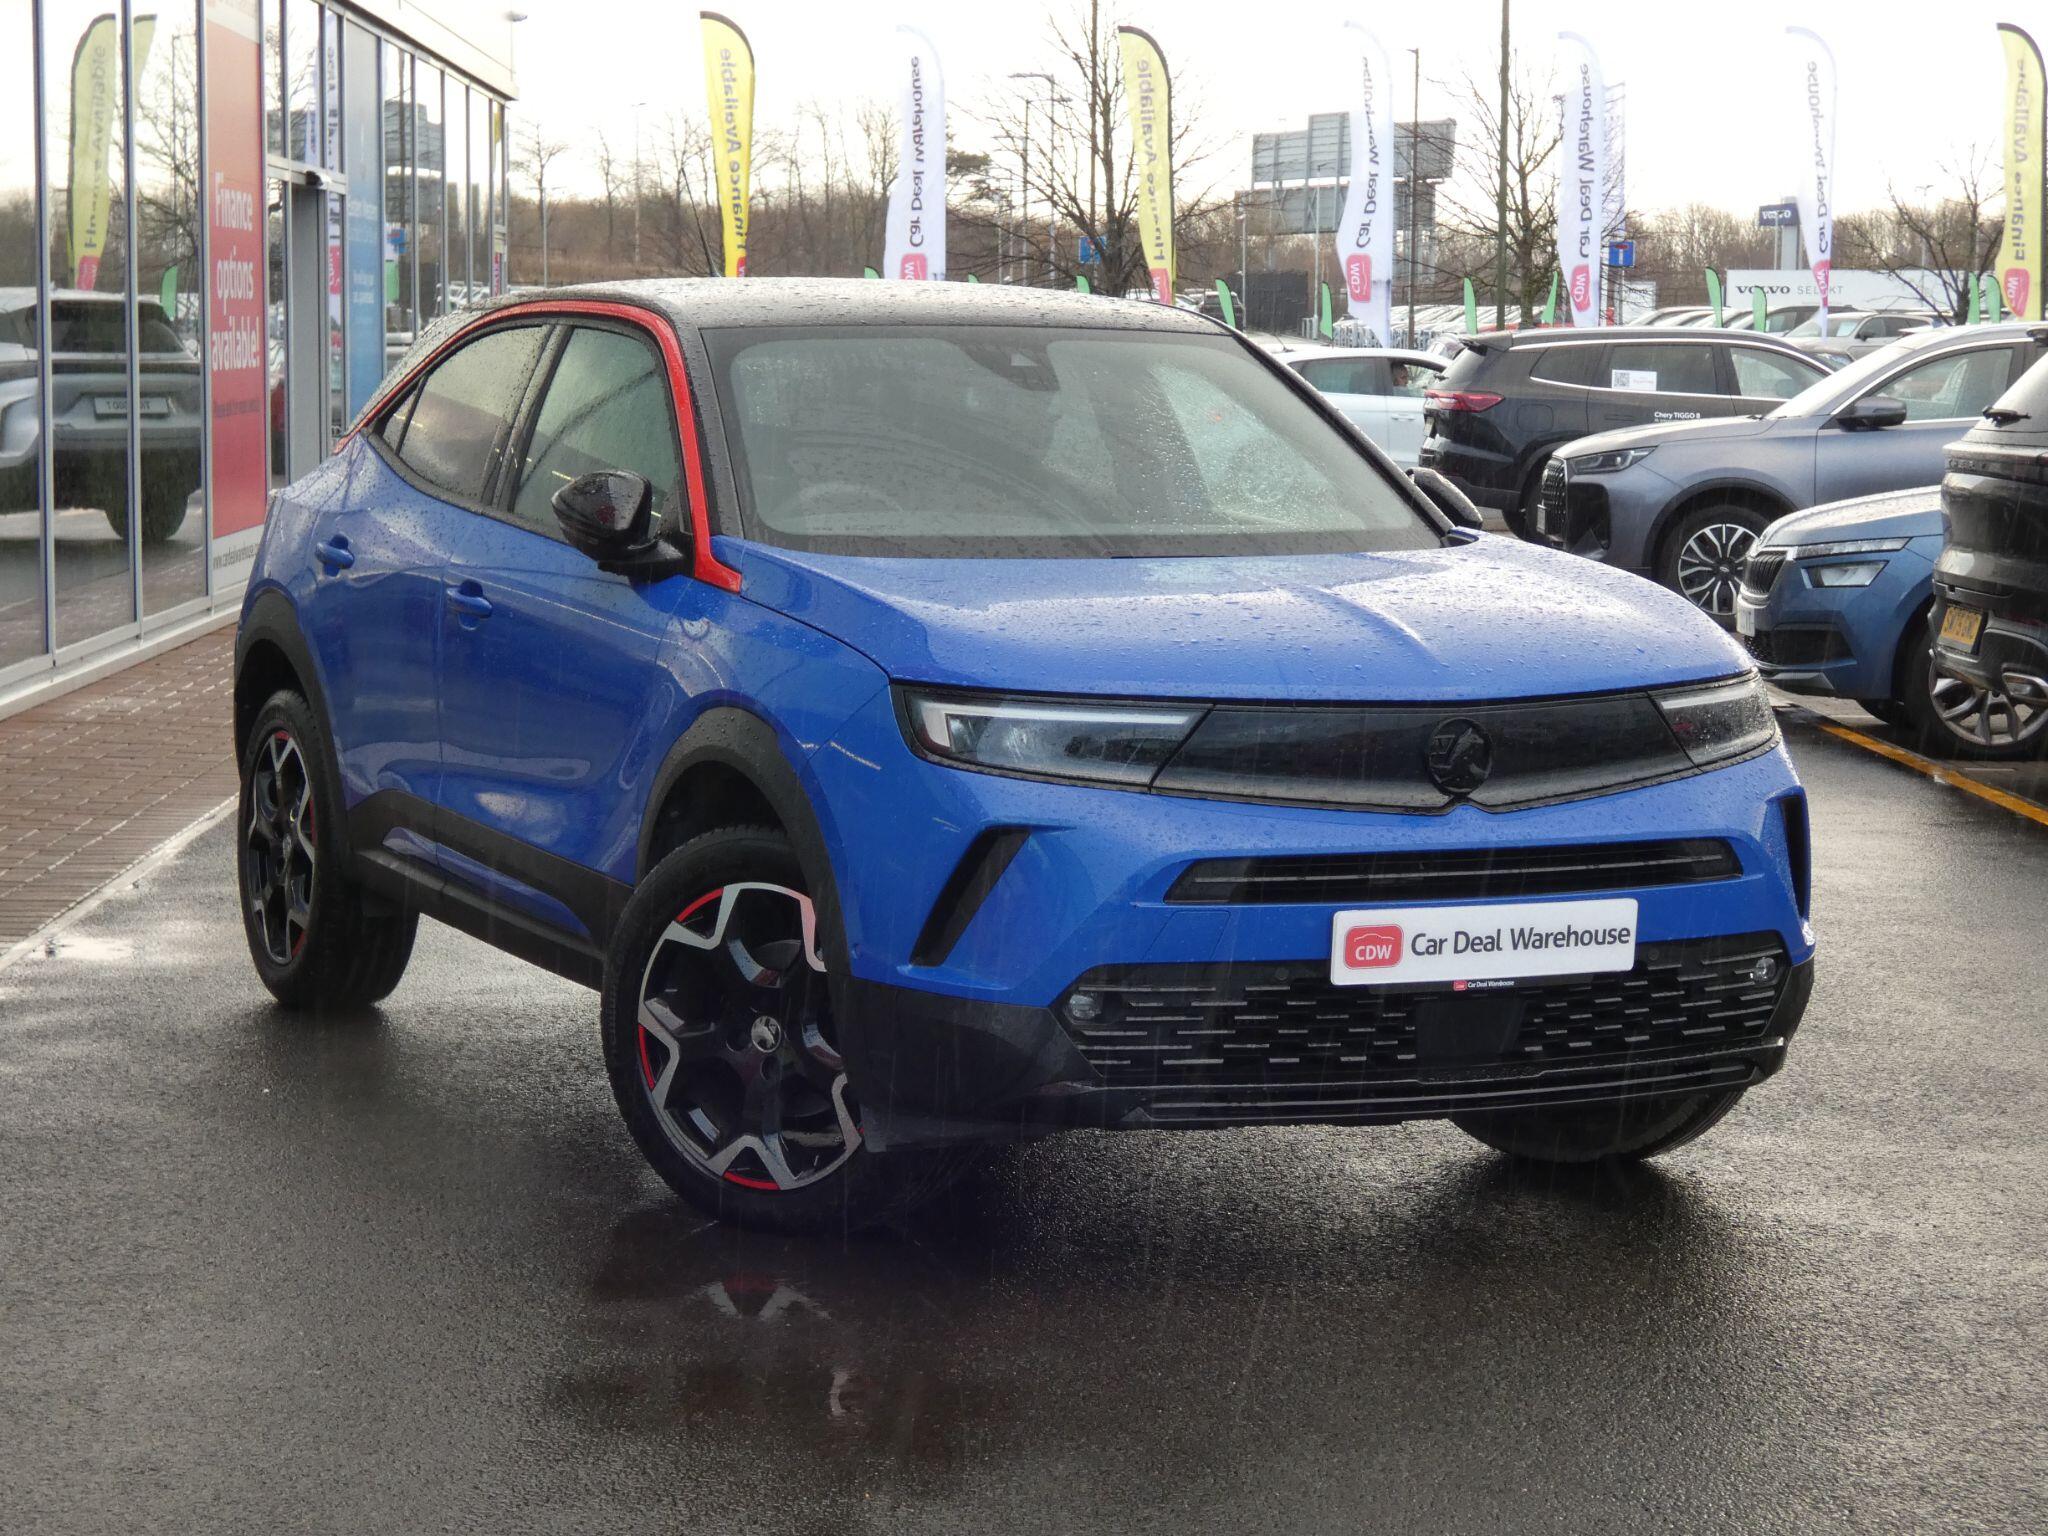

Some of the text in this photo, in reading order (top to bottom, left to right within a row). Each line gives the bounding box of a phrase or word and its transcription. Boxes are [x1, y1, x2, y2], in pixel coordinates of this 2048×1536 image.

[214, 171, 253, 232] Finance
[216, 243, 254, 315] options
[1797, 285, 1844, 295] SELKT
[211, 315, 260, 371] available!
[1654, 411, 1673, 420] Chery
[1674, 411, 1695, 419] TIGGO
[1411, 924, 1631, 956] Car Deal Warehouse
[1354, 944, 1393, 961] CDW
[1476, 980, 1487, 988] Deal
[1488, 979, 1515, 988] Warehouse
